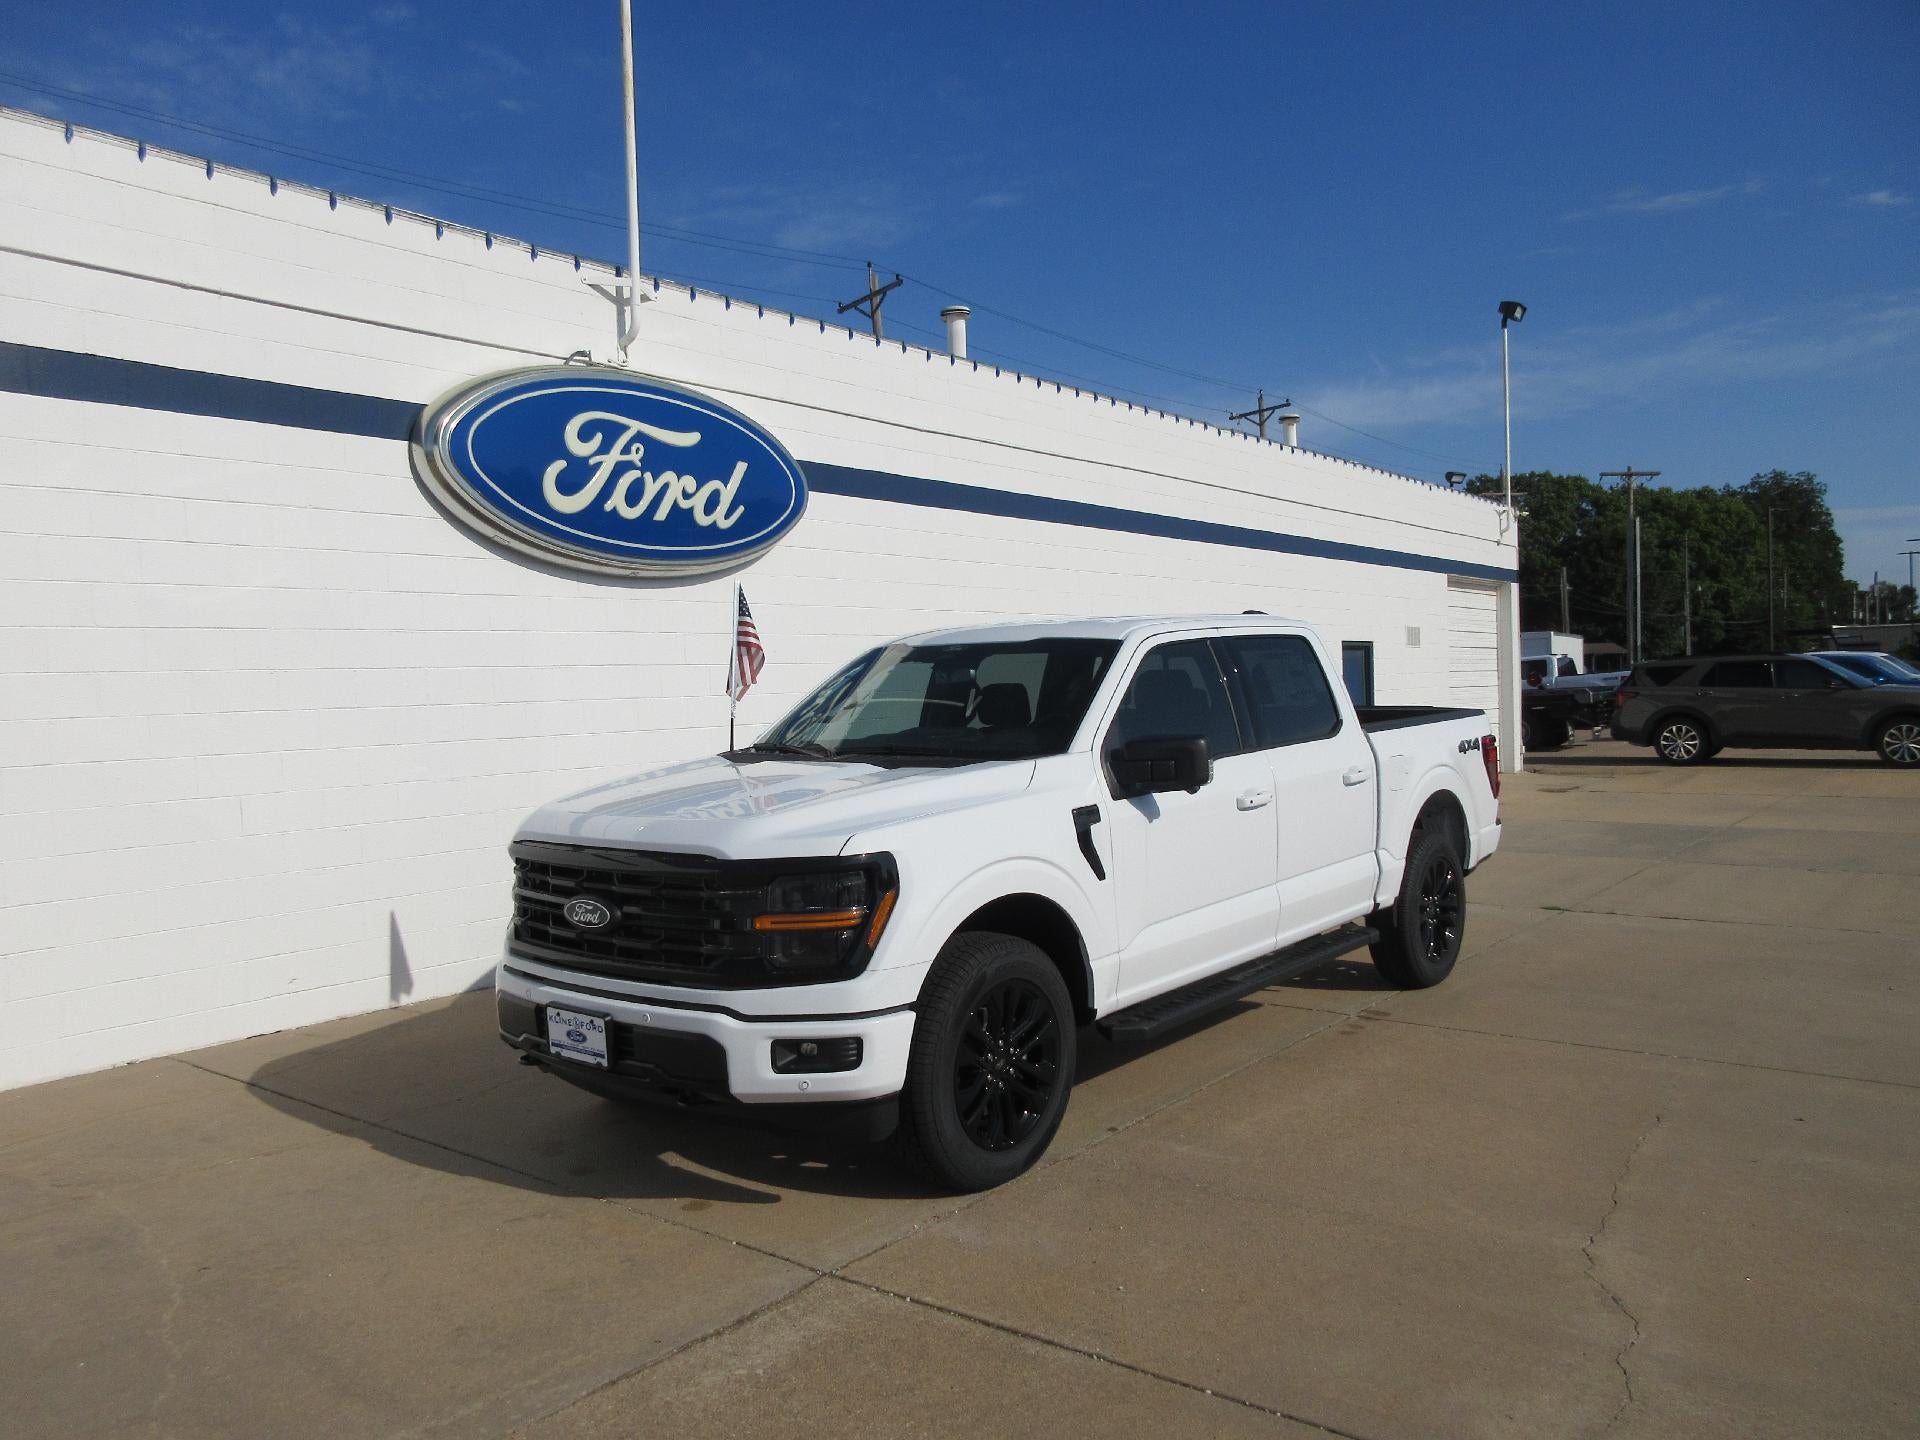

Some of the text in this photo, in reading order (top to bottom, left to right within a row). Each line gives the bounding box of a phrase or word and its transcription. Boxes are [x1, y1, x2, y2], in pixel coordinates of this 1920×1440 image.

[542, 411, 748, 530] Ford
[572, 903, 600, 924] Ford
[580, 1021, 604, 1034] FORD
